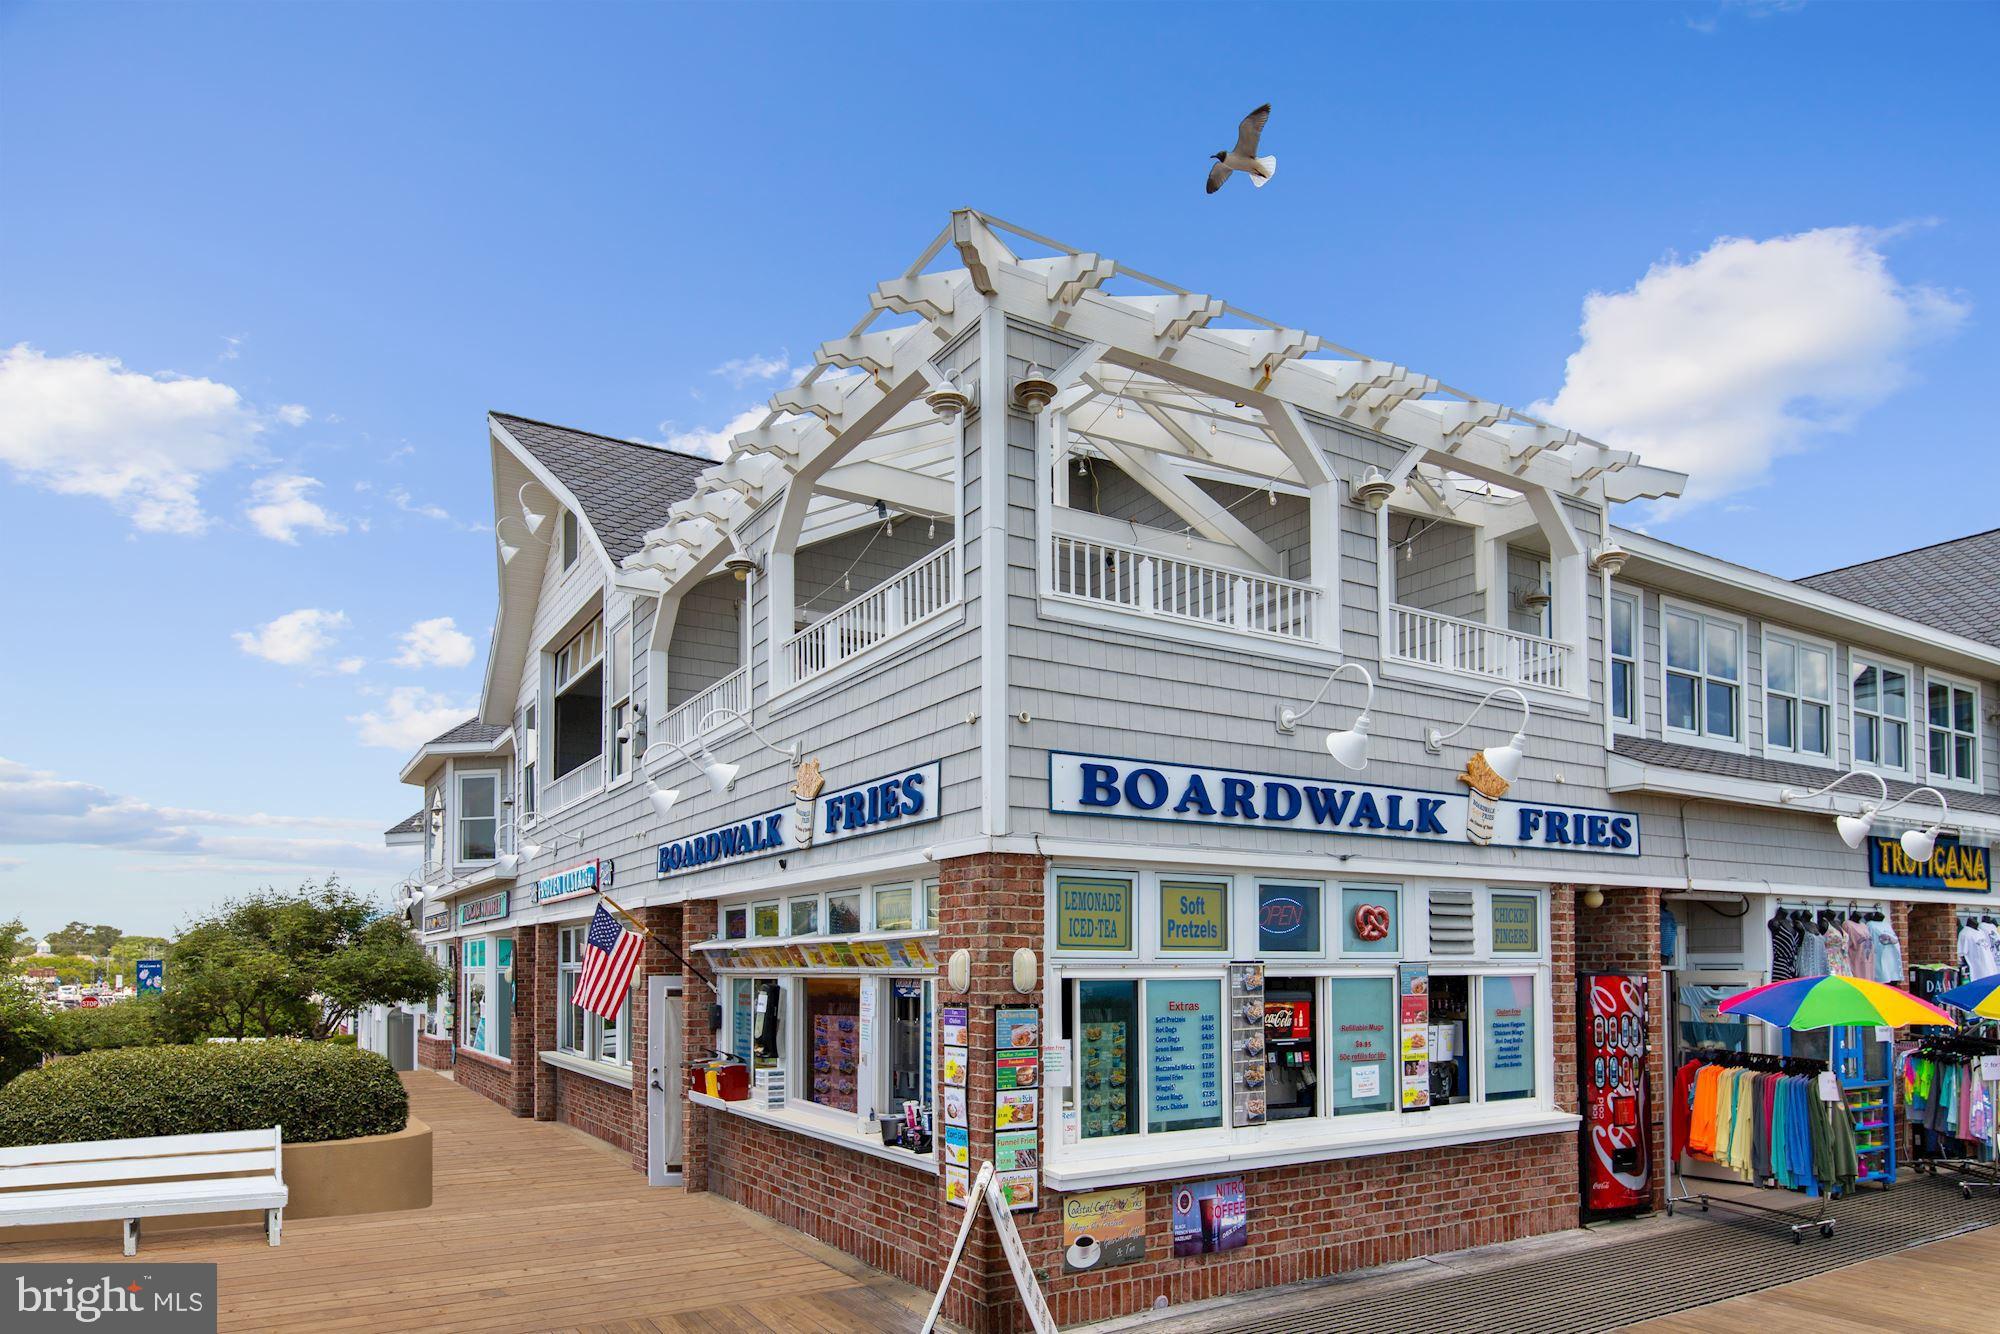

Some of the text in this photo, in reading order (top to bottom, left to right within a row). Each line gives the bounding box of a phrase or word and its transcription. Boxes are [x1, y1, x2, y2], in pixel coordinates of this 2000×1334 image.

[1079, 763, 1632, 849] BOARDWALK FRIES
[658, 773, 925, 873] BOARDWALK FRIES
[1064, 891, 1121, 912] LEMONADE
[1180, 896, 1205, 915] Soft
[1258, 905, 1303, 926] OPEN
[1494, 908, 1528, 923] CHICKEN
[1069, 918, 1118, 939] ICED-TEA
[1167, 919, 1217, 939] Pretzels
[1495, 928, 1528, 944] FINGERS
[82, 1000, 98, 1008] STOP
[1168, 1002, 1200, 1011] Extras
[1341, 1024, 1384, 1032] Refillable Mugs
[1021, 1137, 1036, 1145] Fries
[1216, 1181, 1245, 1197] NITRO
[1068, 1200, 1094, 1218] Coastal
[1095, 1200, 1116, 1218] Coffee
[1208, 1201, 1246, 1219] COFFEE
